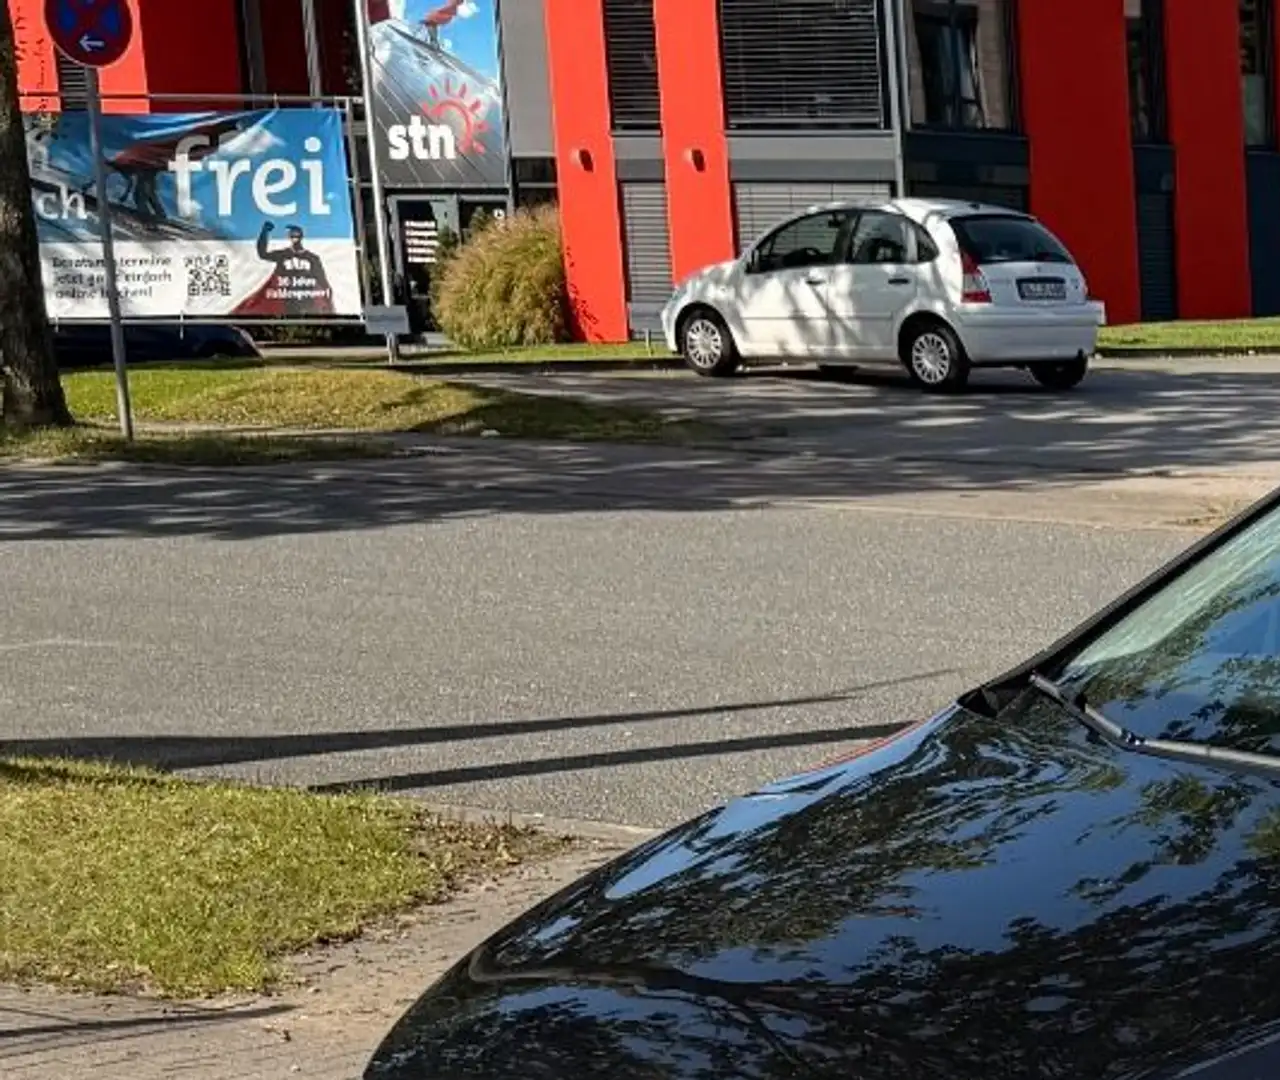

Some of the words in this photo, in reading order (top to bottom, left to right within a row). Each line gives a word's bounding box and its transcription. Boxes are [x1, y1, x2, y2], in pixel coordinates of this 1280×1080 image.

[388, 115, 456, 160] stn
[168, 134, 330, 217] frei
[36, 180, 88, 220] ch
